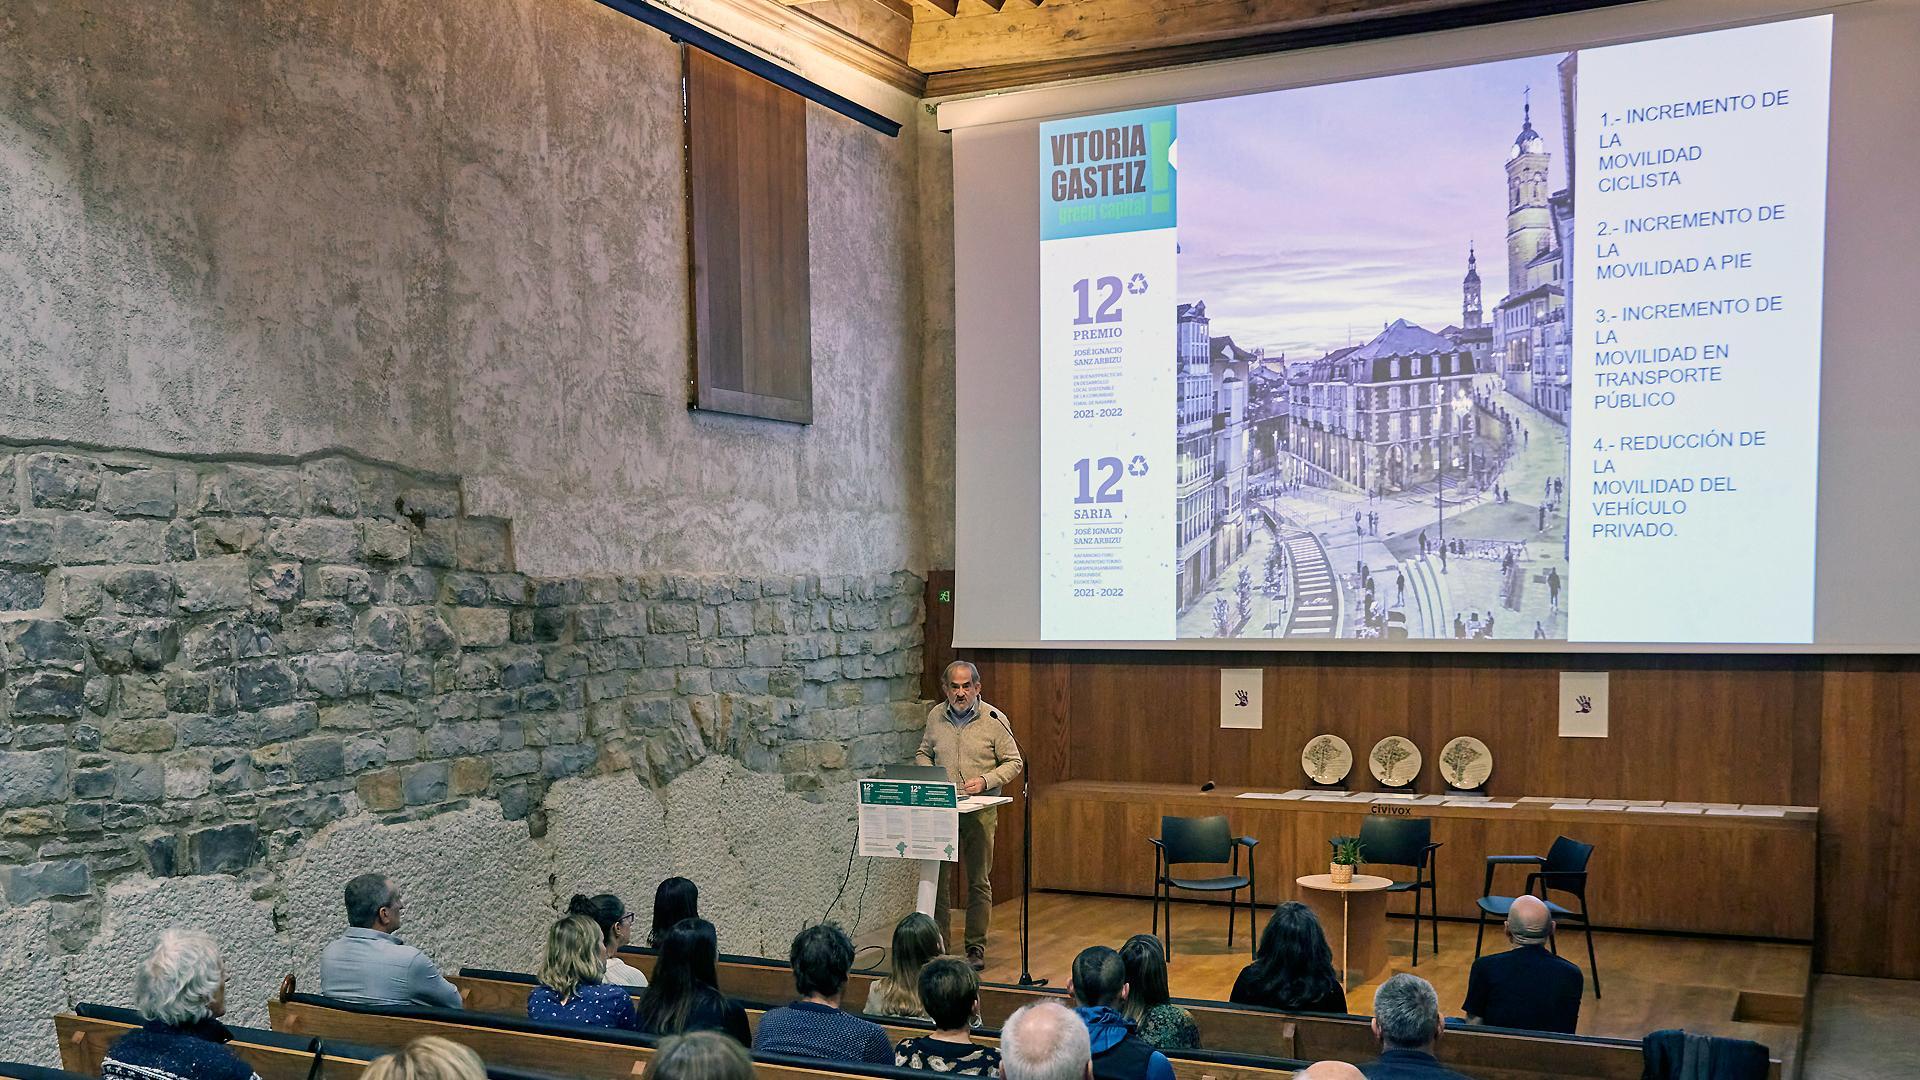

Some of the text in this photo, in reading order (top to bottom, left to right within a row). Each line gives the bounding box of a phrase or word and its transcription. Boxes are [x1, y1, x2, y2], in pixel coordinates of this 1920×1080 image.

[1601, 89, 1790, 127] 1.- INCREMENTO DE
[1050, 124, 1147, 167] VITORIA
[1599, 132, 1622, 149] LA
[1599, 145, 1702, 171] MOVILIDAD
[1051, 159, 1146, 202] GASTEIZ
[1598, 171, 1682, 193] CICLISTA
[1058, 196, 1147, 226] green capital
[1597, 204, 1786, 236] 2.- INCREMENTO DE
[1597, 243, 1620, 258] LA
[1596, 252, 1753, 280] MOVILIDAD A PIE
[1073, 276, 1123, 325] 12
[1596, 295, 1783, 324] 3.- INCREMENTO DE
[1073, 328, 1123, 340] PREMIO
[1596, 329, 1618, 344] LA
[1092, 347, 1122, 355] IGNACIO
[1595, 343, 1730, 366] MOVILIDAD EN
[1074, 358, 1093, 366] SANZ
[1595, 366, 1723, 387] TRANSPORTE
[1594, 391, 1675, 409] PÚBLICO
[1593, 429, 1766, 452] 4.- REDUCCIÓN DE
[1593, 459, 1616, 474] LA
[1073, 457, 1124, 504] 12
[1593, 477, 1737, 495] MOVILIDAD DEL
[1073, 508, 1112, 519] SARIA
[1592, 497, 1687, 516] VEHÍCULO
[1092, 527, 1123, 535] IGNACIO
[1592, 522, 1678, 538] PRIVADO.
[1371, 804, 1411, 814] civivox
